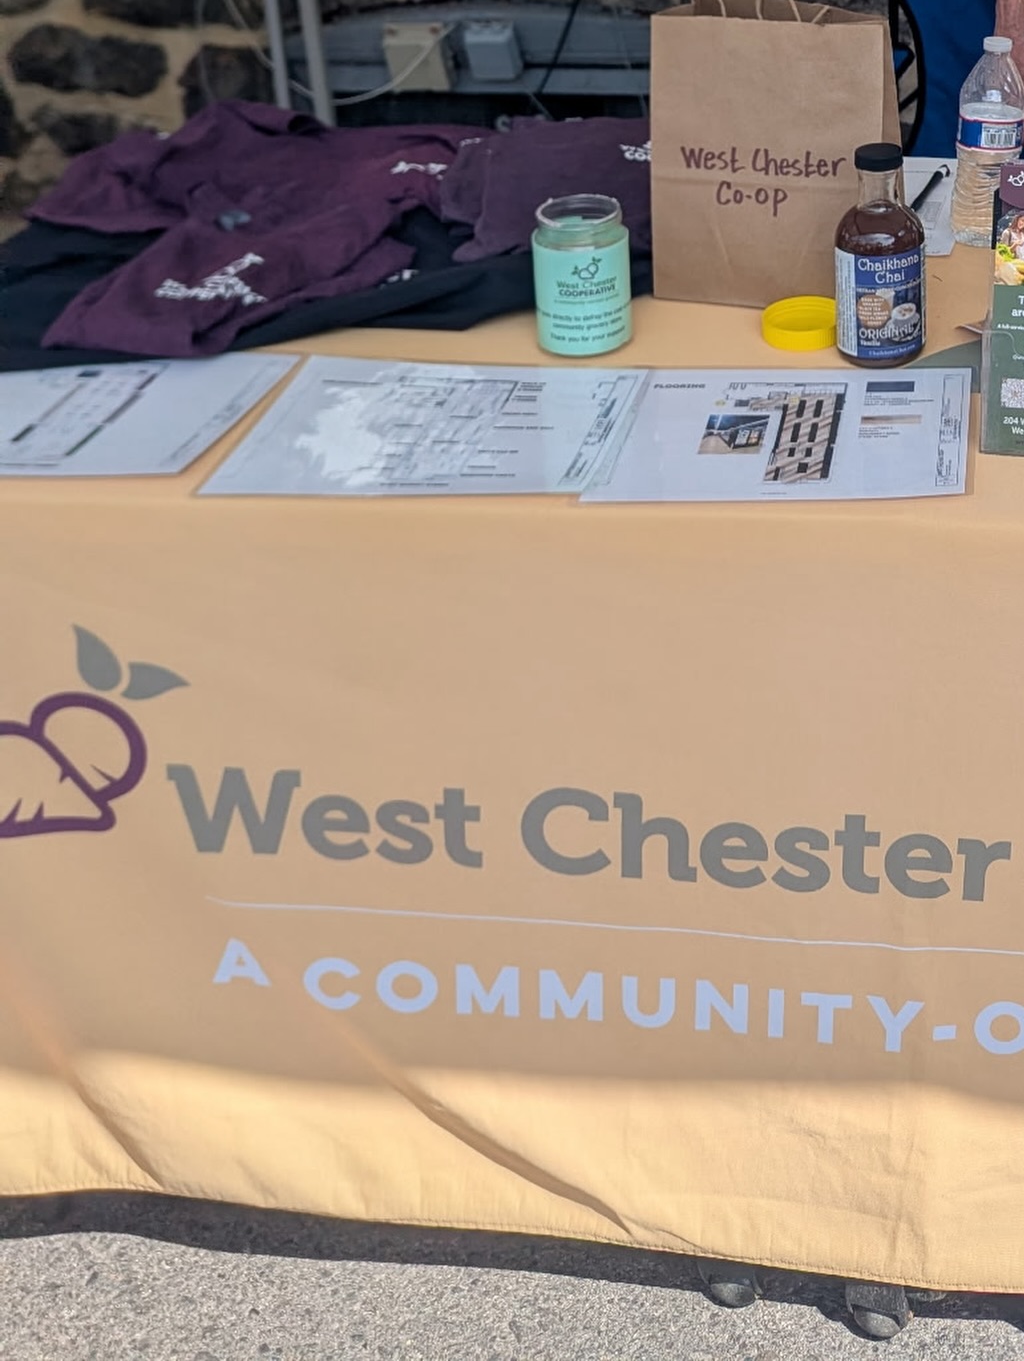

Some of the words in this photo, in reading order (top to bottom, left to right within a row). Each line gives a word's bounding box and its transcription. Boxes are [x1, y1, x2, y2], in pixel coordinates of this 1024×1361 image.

[680, 146, 746, 173] West
[751, 148, 847, 178] Chester
[716, 180, 788, 217] Co-op
[875, 269, 905, 284] Chai
[557, 281, 579, 289] West
[559, 284, 615, 297] COOPERATIVE
[859, 324, 915, 339] ORIGINAL
[1003, 416, 1018, 424] 204
[166, 763, 484, 869] West
[520, 787, 1012, 902] Chester
[213, 938, 271, 987] A
